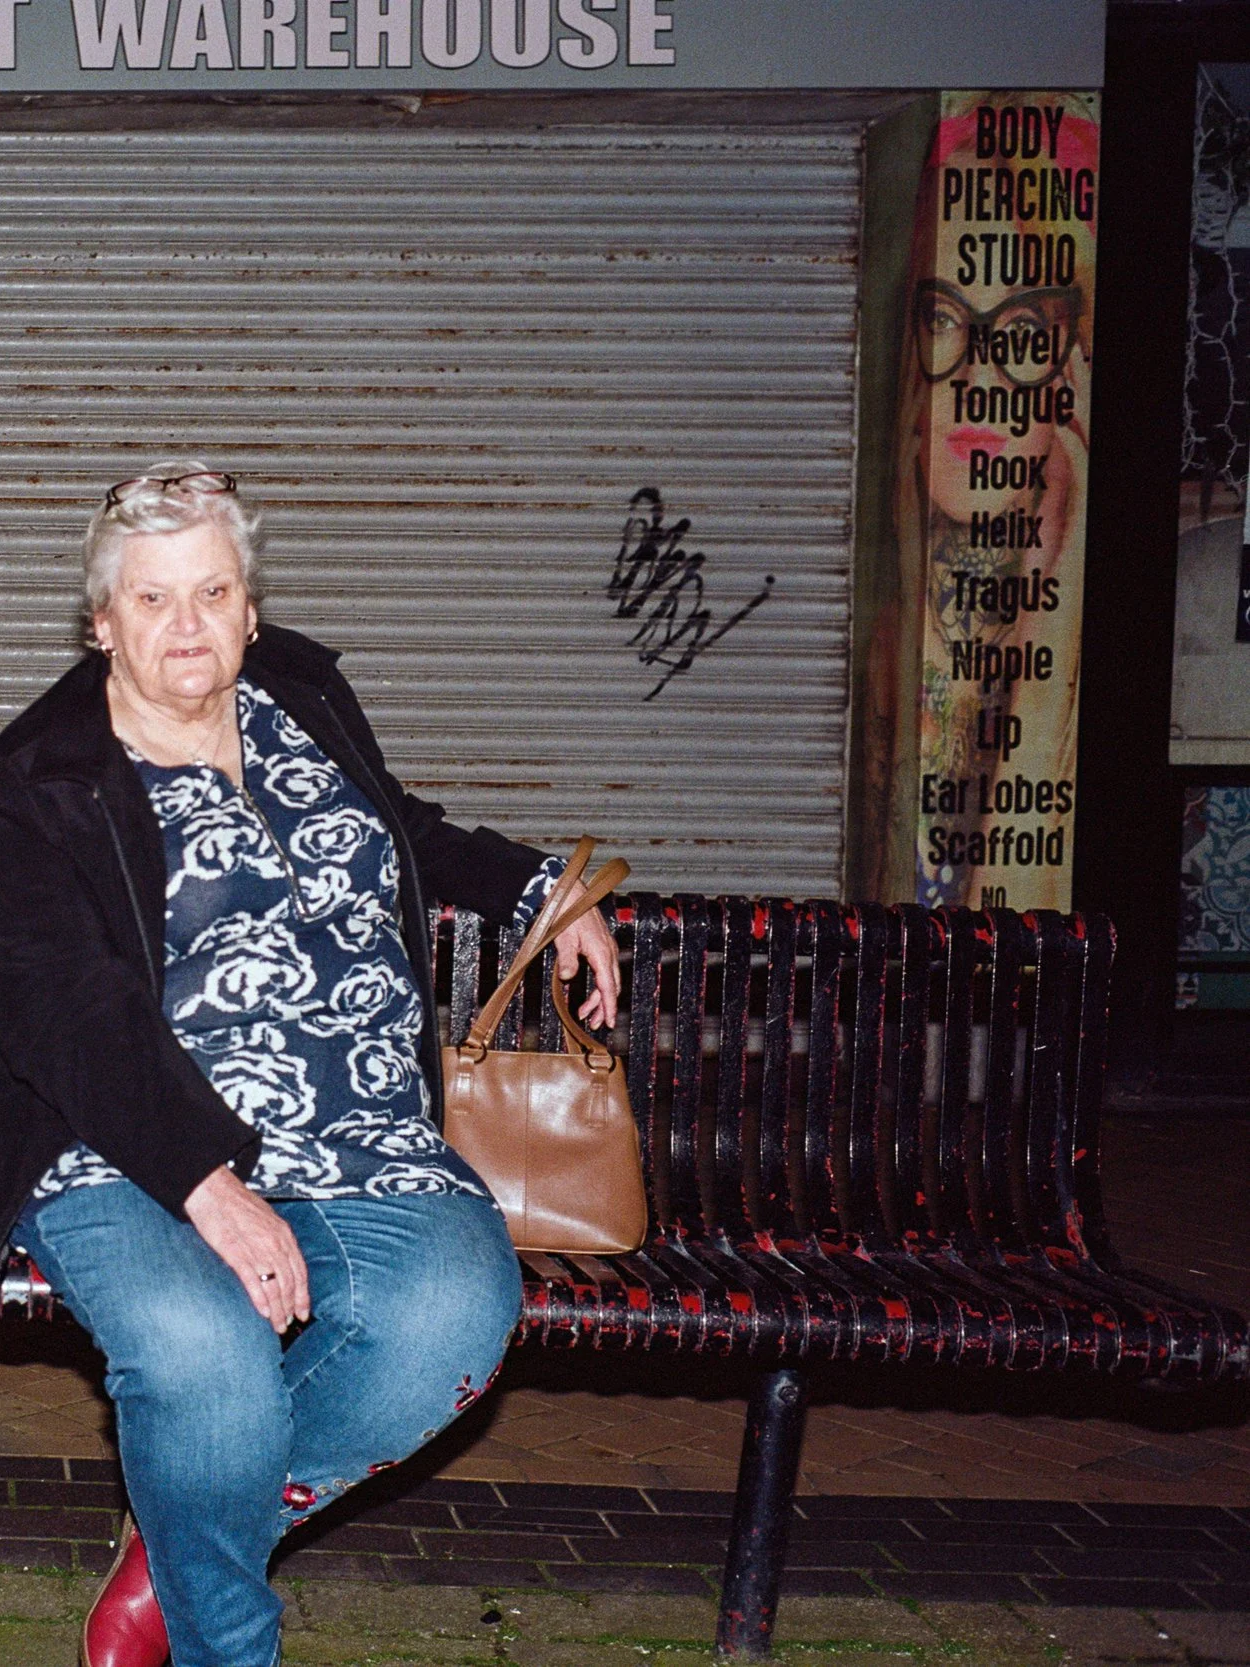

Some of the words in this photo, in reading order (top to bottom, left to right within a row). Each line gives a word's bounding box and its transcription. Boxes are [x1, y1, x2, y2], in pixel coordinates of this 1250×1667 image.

[70, 0, 677, 70] WAREHOUSE
[976, 106, 1064, 160] BODY
[943, 168, 1094, 221] PIERCING
[957, 233, 1075, 286] STUDIO
[967, 324, 1059, 365] Navel
[950, 379, 1074, 437] Tongue
[970, 510, 1043, 550] Helix
[952, 571, 1059, 624] Tragus
[952, 640, 1052, 693] Nipple
[977, 706, 1021, 762] Lip
[922, 774, 969, 814] Ear
[979, 774, 1072, 814] Lobes
[928, 826, 1063, 867] Scaffold
[981, 886, 1006, 909] NO
